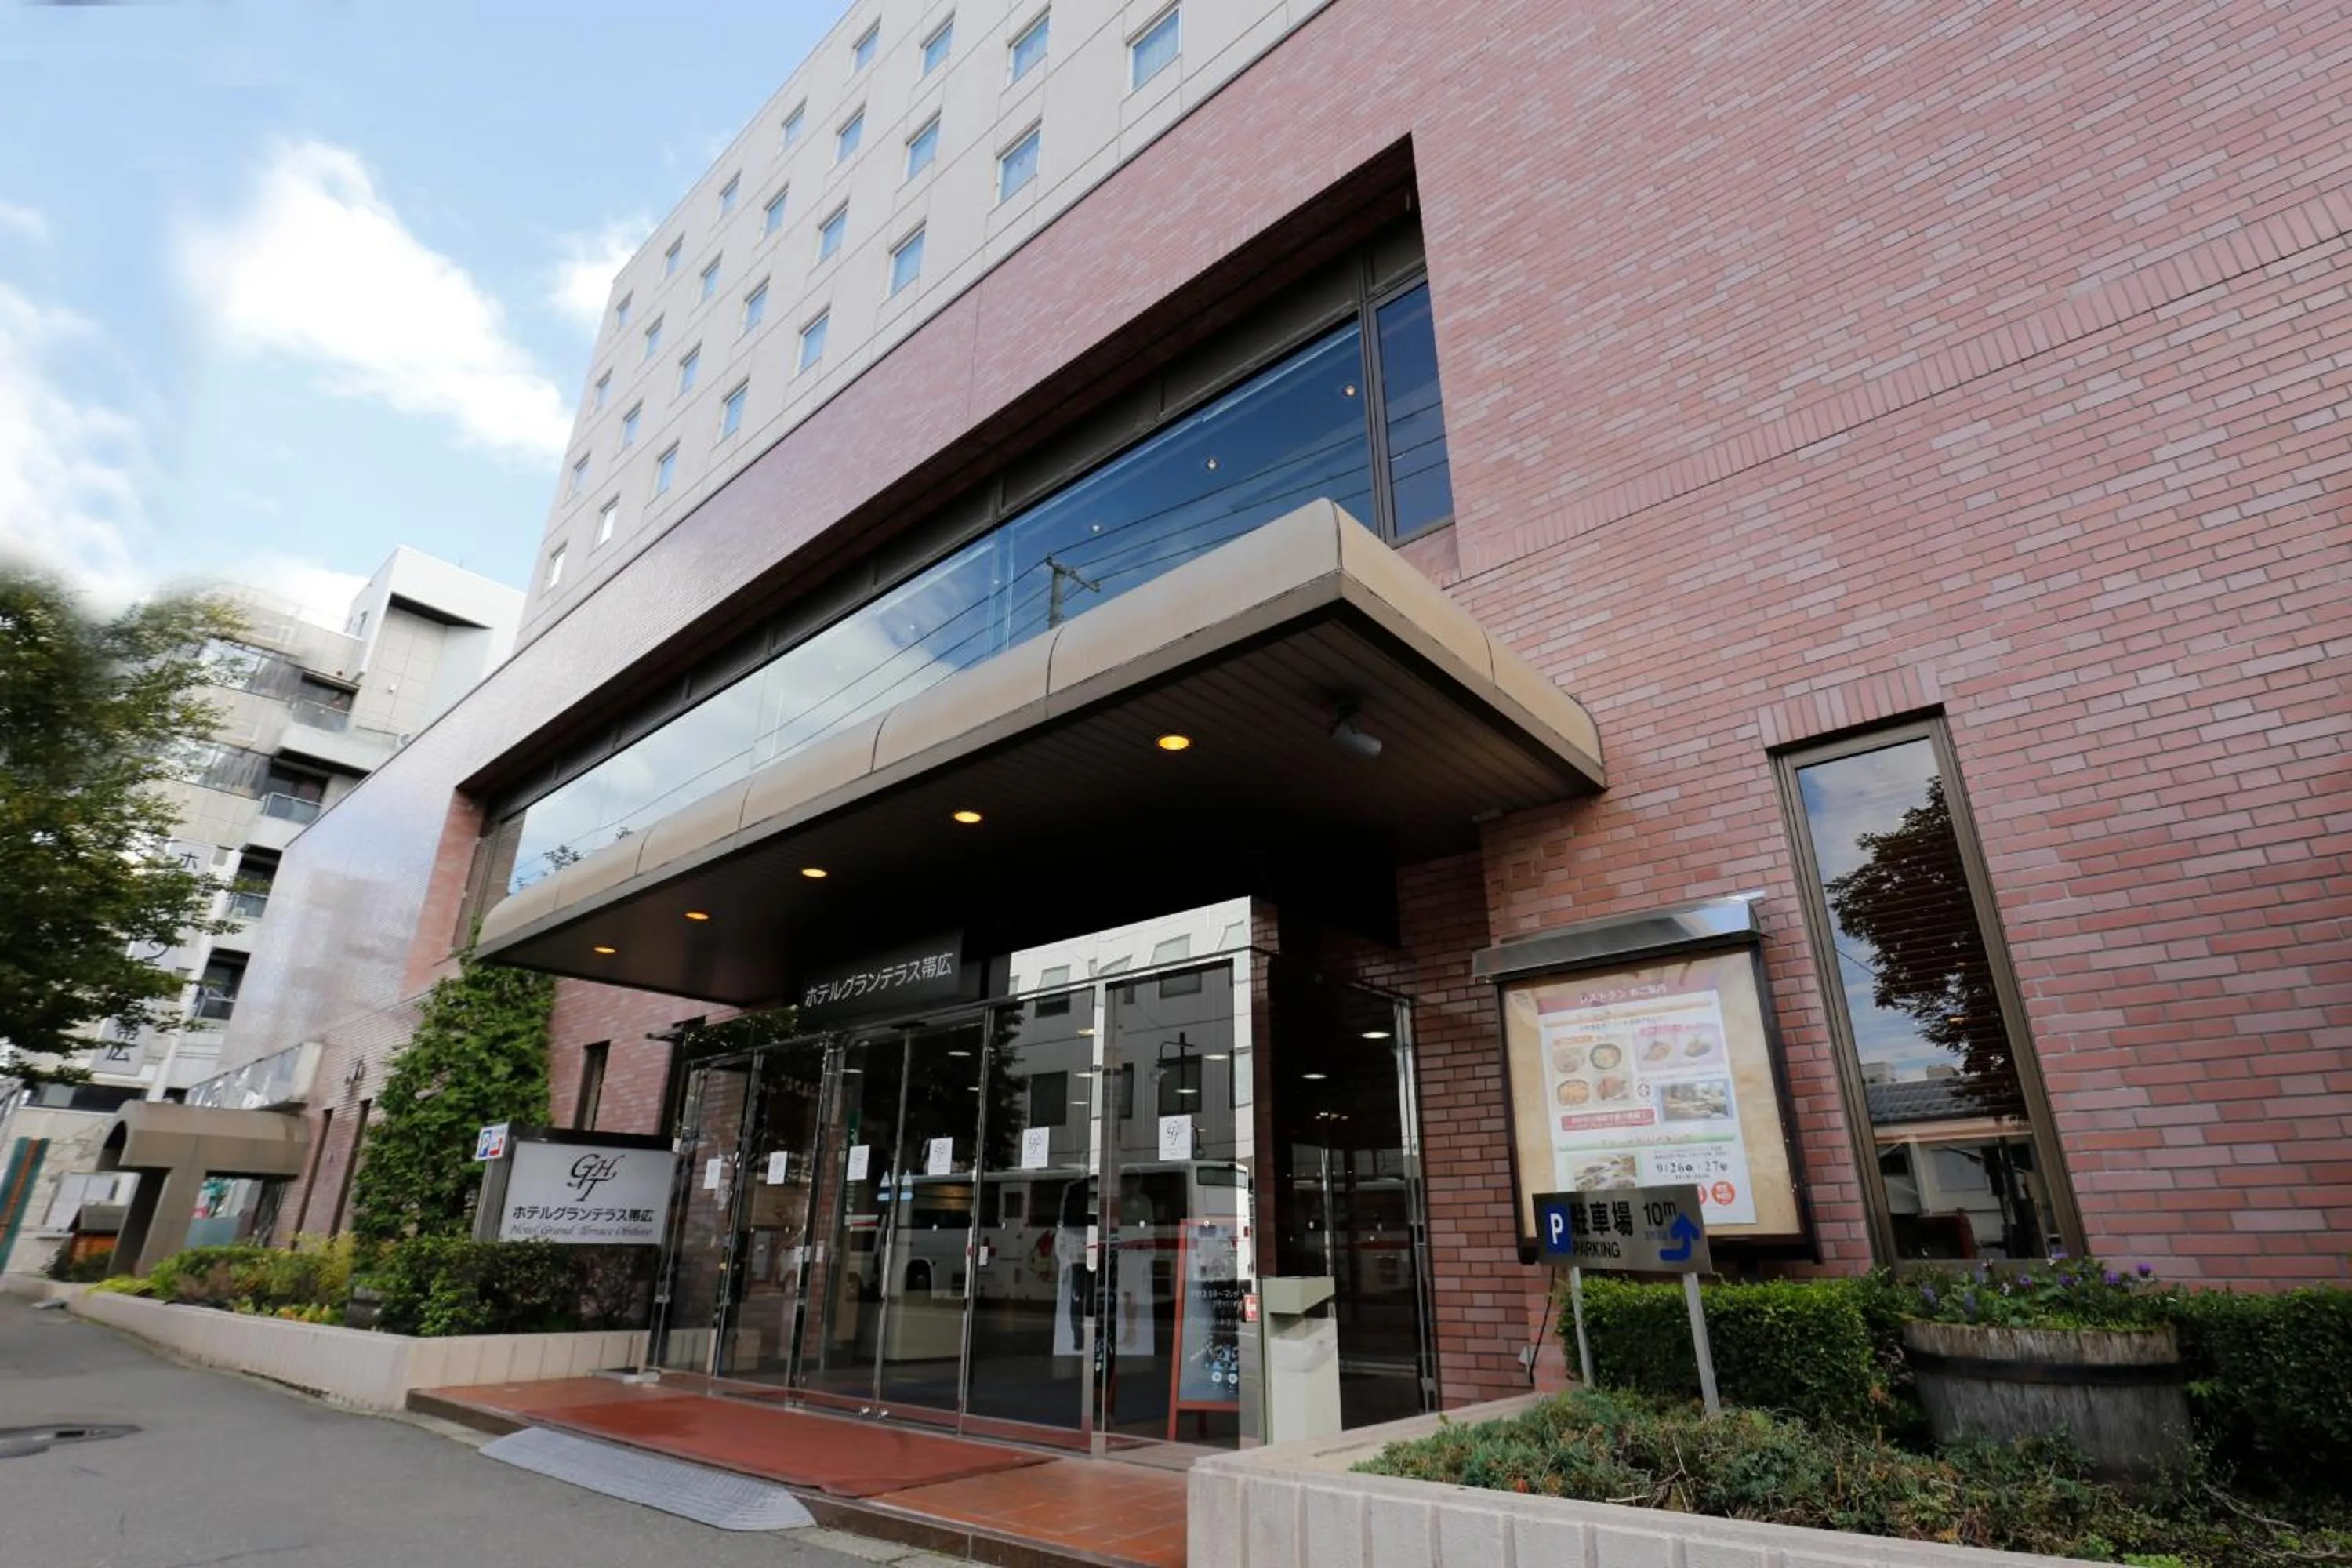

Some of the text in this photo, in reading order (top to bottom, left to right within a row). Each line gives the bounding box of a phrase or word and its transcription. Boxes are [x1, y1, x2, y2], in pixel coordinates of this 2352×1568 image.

[804, 952, 954, 1007] ホテルグランテラス帯広
[513, 1206, 655, 1222] ホテルグランテラス帯広
[1570, 1200, 1634, 1237] 駐車場
[1643, 1200, 1677, 1227] 10m
[1549, 1212, 1564, 1246] P
[1573, 1240, 1621, 1258] PARKING
